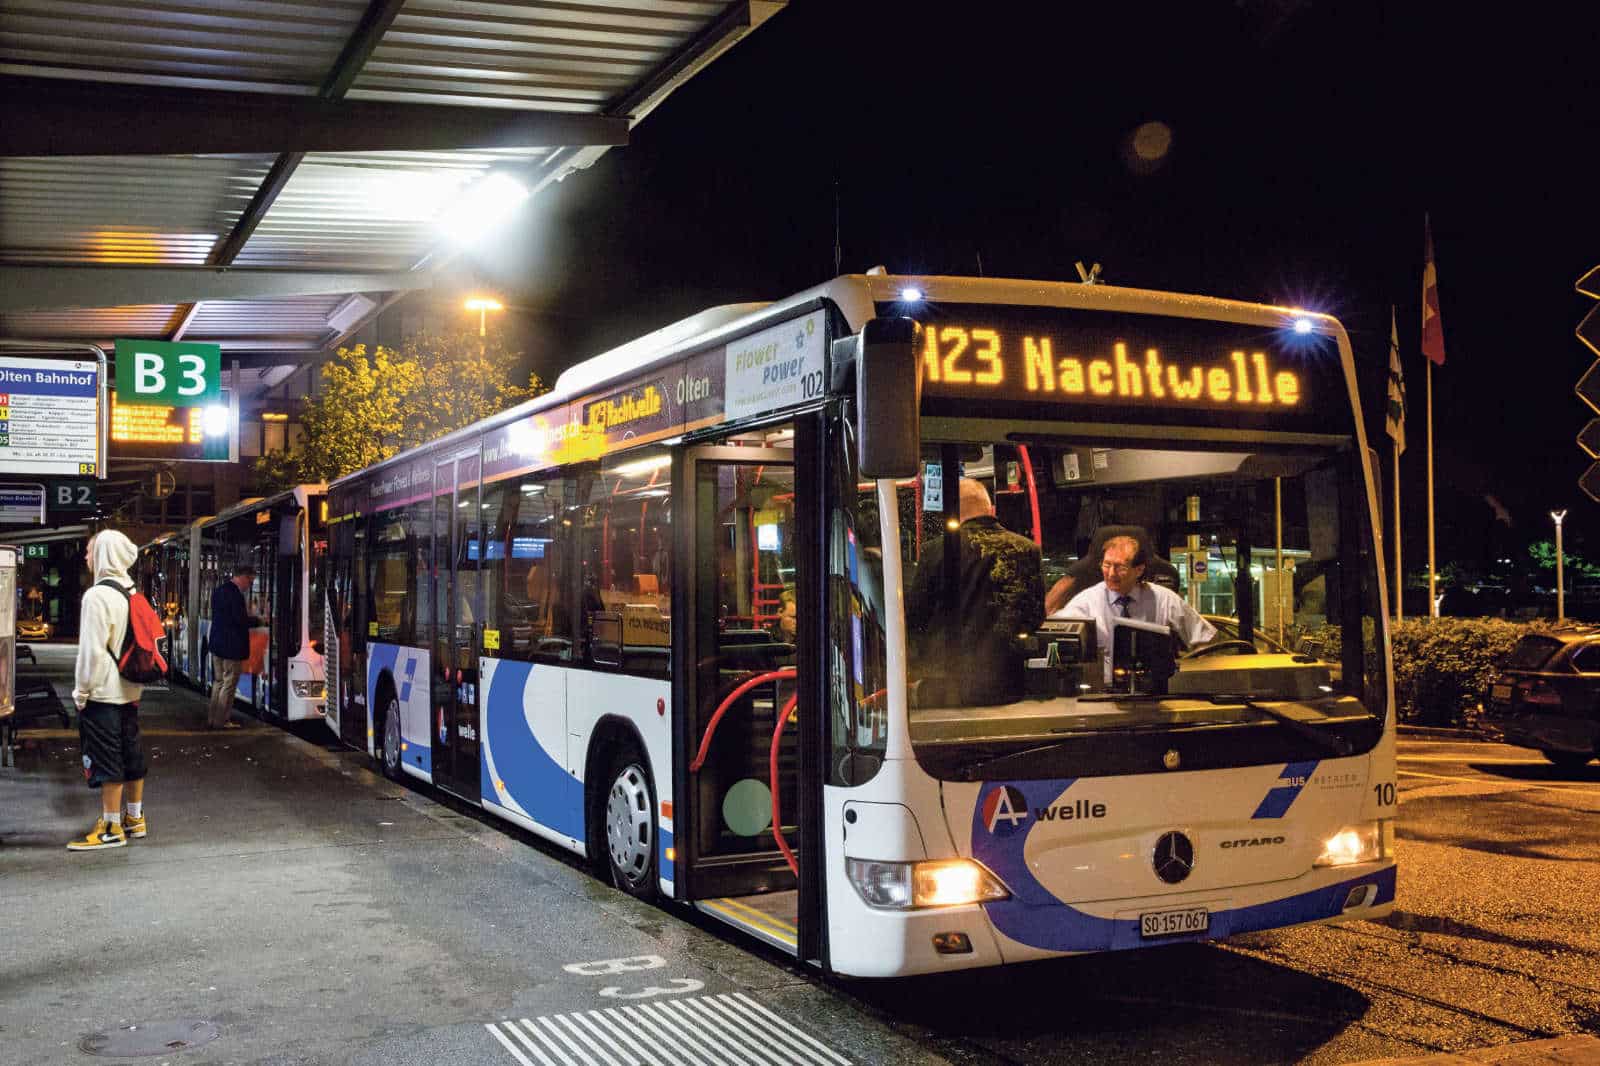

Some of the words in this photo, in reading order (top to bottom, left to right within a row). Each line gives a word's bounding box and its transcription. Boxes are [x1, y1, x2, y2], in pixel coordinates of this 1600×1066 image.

[36, 372, 93, 386] Bahnhof
[1023, 336, 1299, 404] Nachtwelle
[676, 374, 710, 405] Olten
[801, 370, 824, 399] 102
[1374, 783, 1397, 807] 10
[1034, 799, 1107, 821] welle
[1219, 836, 1286, 849] CITARO
